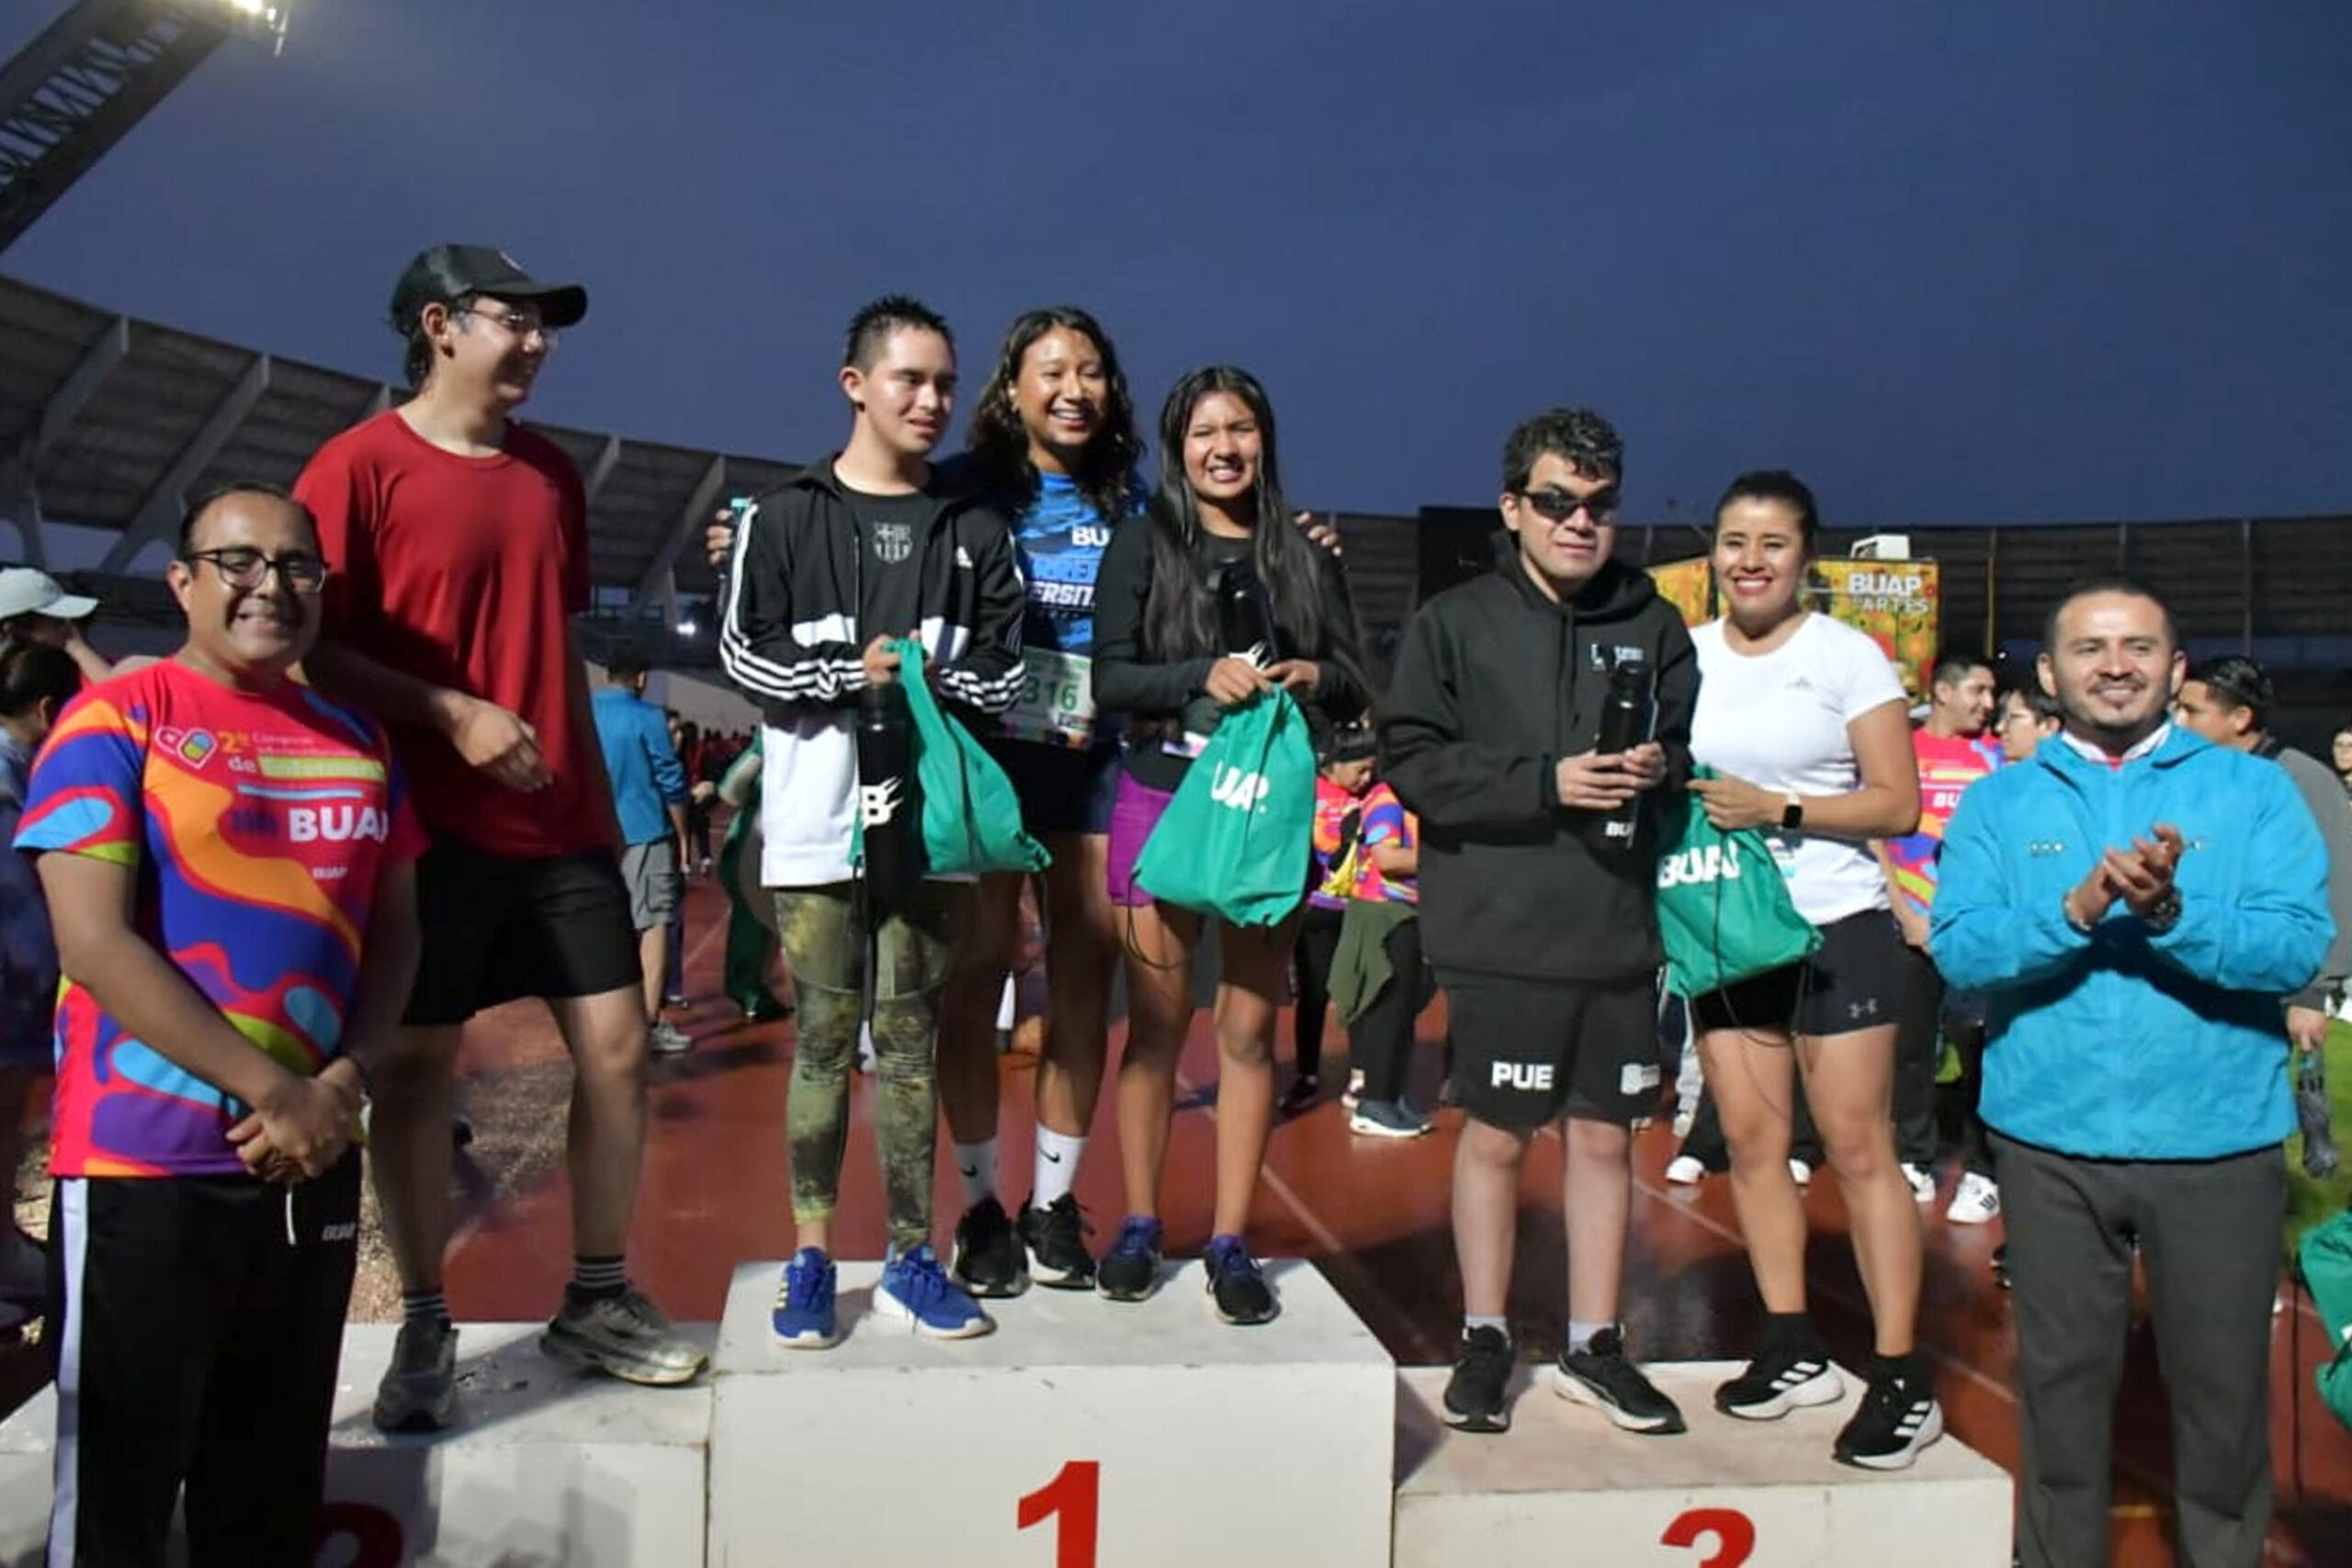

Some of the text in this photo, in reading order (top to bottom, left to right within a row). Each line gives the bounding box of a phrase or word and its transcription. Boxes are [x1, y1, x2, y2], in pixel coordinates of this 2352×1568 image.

[1849, 572, 1922, 596] BUAP
[228, 755, 257, 773] de
[289, 805, 389, 842] BUA
[1490, 1060, 1555, 1090] PUE
[1016, 1460, 1100, 1568] 1
